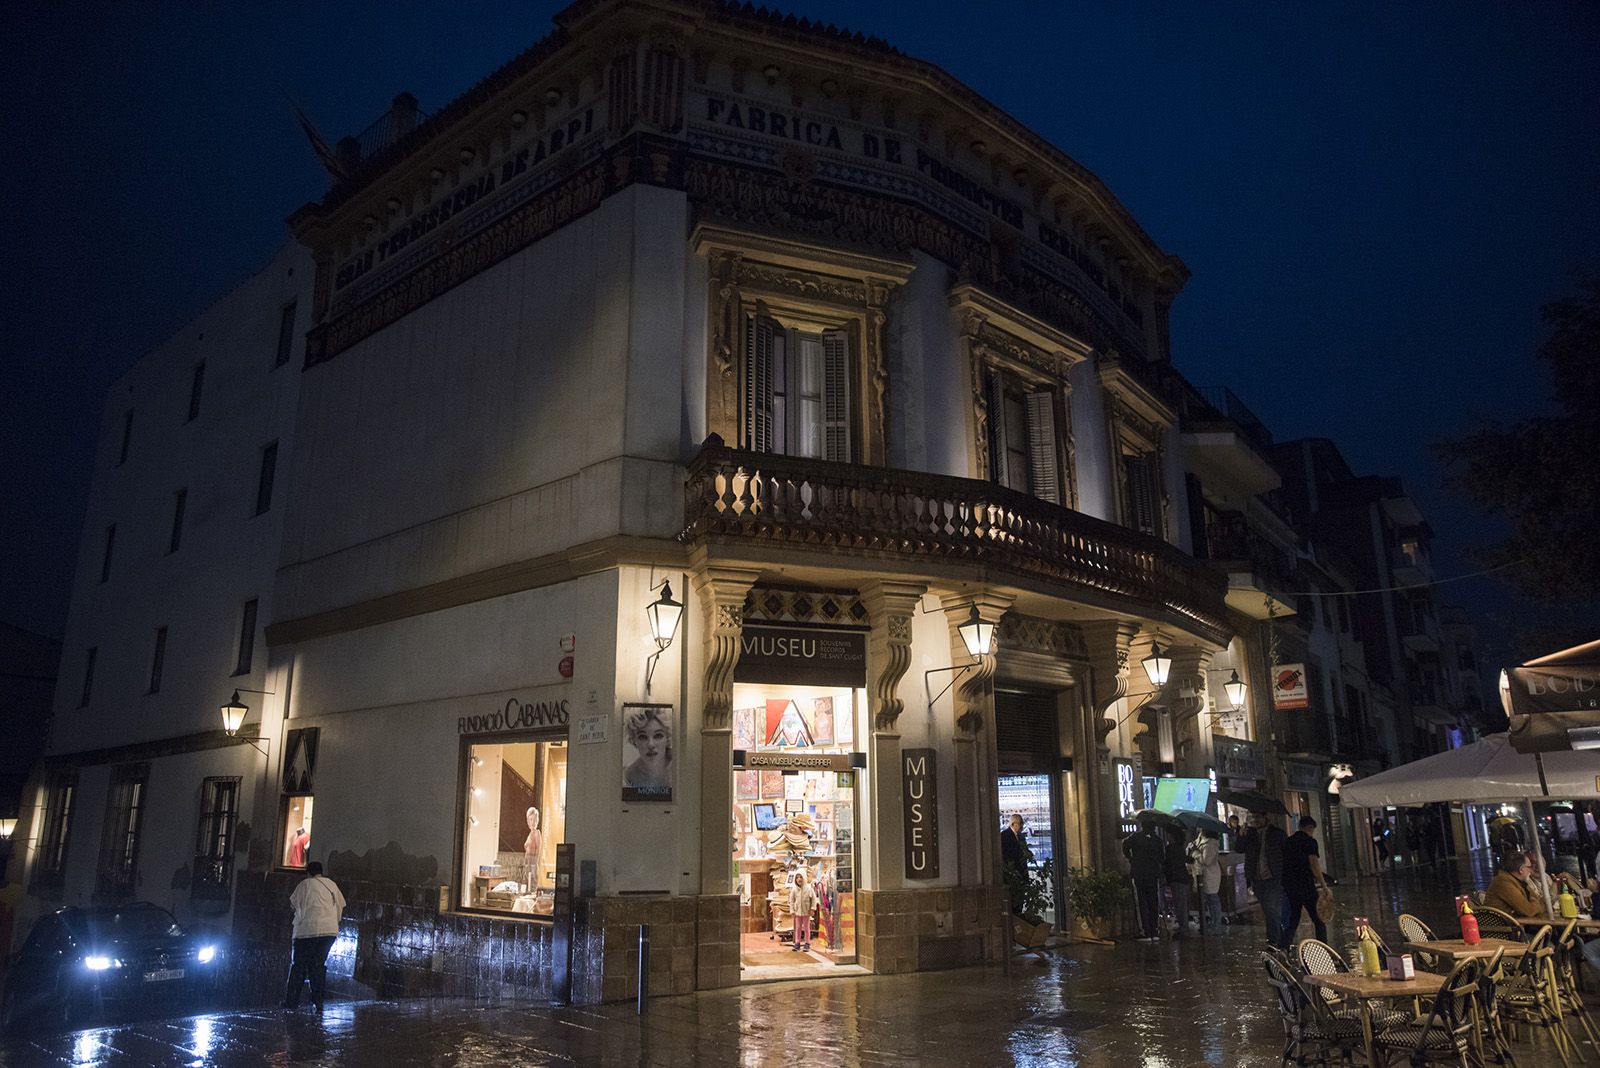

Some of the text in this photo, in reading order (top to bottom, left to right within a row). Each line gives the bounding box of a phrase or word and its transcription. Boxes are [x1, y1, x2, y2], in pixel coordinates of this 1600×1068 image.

[707, 98, 843, 150] FABRICA
[863, 133, 901, 164] DE
[740, 636, 816, 658] MUSEU
[458, 698, 569, 734] FUNDACIÓ CABANAS
[751, 757, 769, 766] CASA
[906, 756, 926, 871] MUSEU
